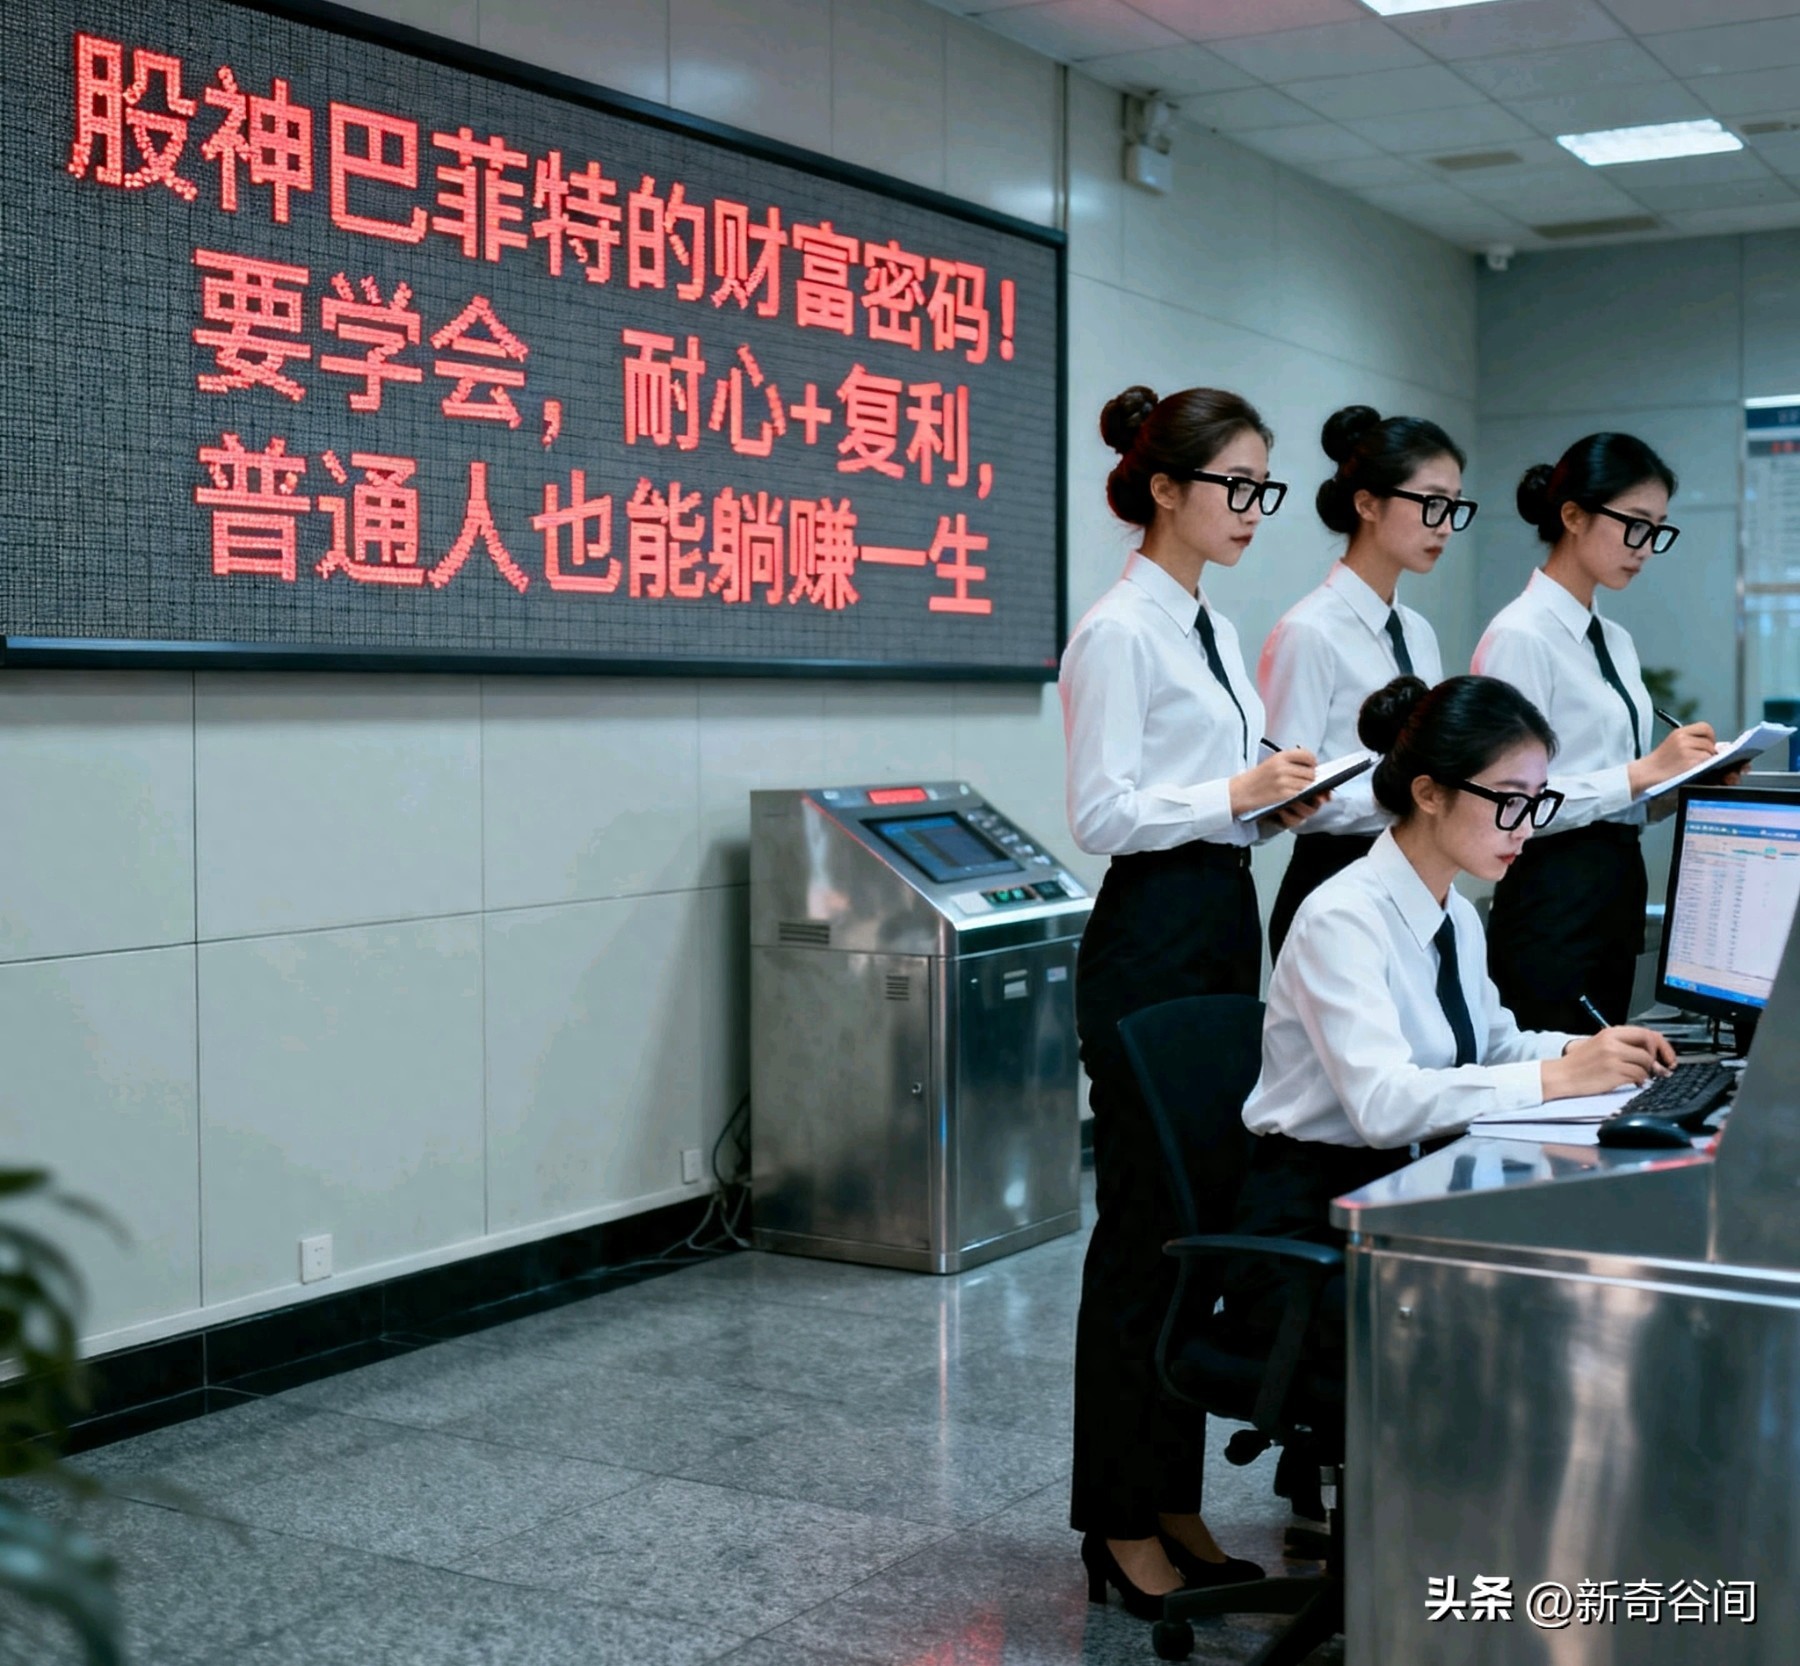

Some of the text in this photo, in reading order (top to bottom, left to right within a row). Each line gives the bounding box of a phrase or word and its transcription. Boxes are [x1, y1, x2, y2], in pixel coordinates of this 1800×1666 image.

[68, 35, 1015, 361] 股神巴菲特的财富密码！
[195, 433, 991, 614] 普通人也能躺赚一生
